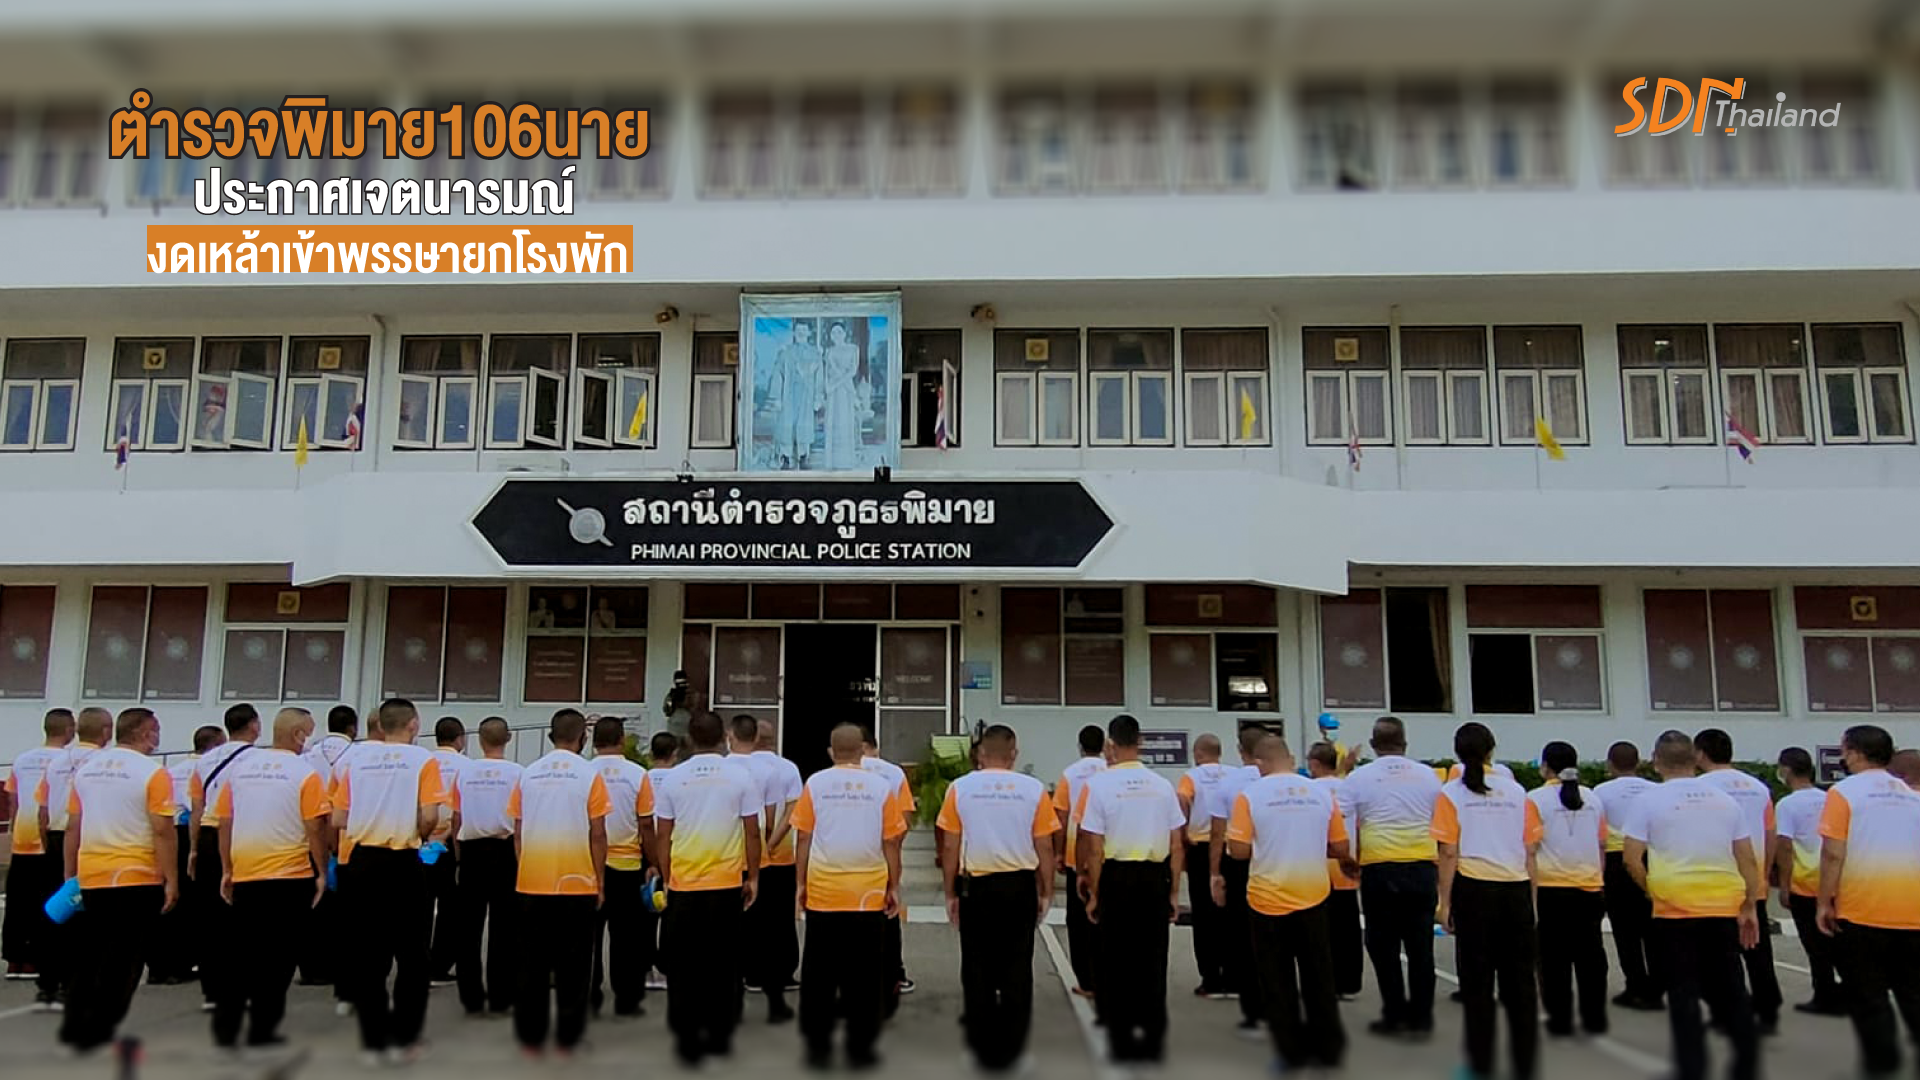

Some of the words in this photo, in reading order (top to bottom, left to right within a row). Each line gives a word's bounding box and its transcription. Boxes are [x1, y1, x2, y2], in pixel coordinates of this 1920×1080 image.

[622, 487, 996, 539] สถานีตำรวจภูธรพิมาย
[630, 543, 696, 560] PHIMAI
[700, 543, 812, 560] PROVINCIAL
[817, 543, 882, 560] POLICE
[887, 543, 972, 560] STATION
